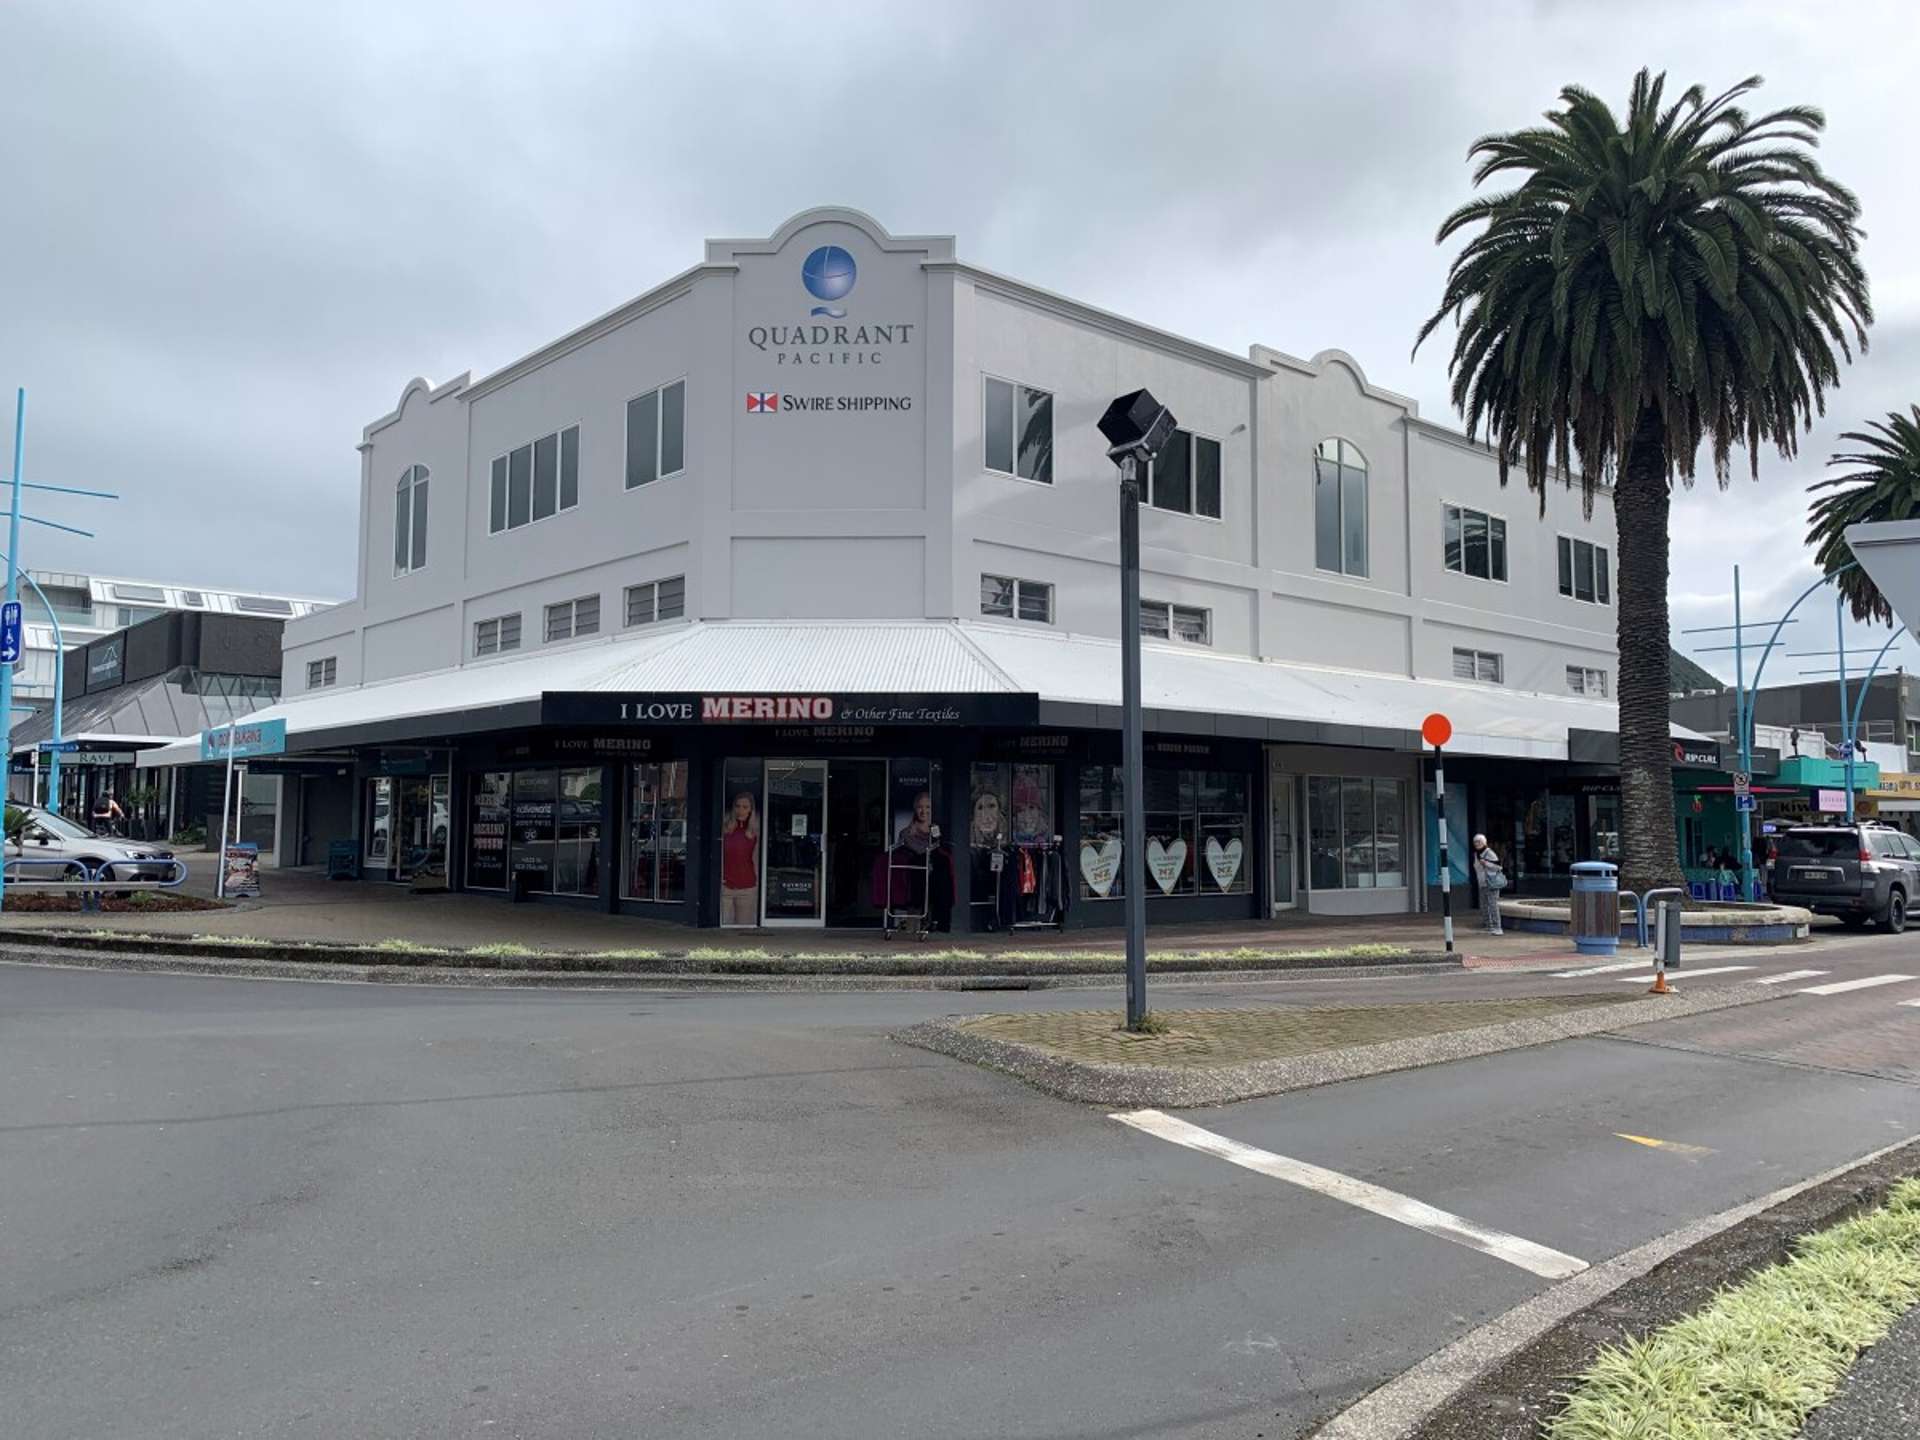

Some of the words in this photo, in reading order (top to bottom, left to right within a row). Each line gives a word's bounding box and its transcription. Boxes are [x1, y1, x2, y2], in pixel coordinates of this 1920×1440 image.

[749, 325, 914, 351] QUADRANT
[777, 352, 882, 365] PACIFIC
[783, 395, 834, 411] SWIRE
[837, 396, 912, 411] SHIPPING
[620, 703, 628, 720] I
[636, 703, 693, 720] LOVE
[702, 697, 834, 720] MERINO
[841, 709, 854, 720] &
[855, 706, 887, 720] Other
[887, 707, 914, 721] Fine
[916, 706, 960, 722] Textiles
[814, 725, 874, 737] MERINO
[593, 737, 652, 750] MERINO
[79, 753, 114, 763] RAVE
